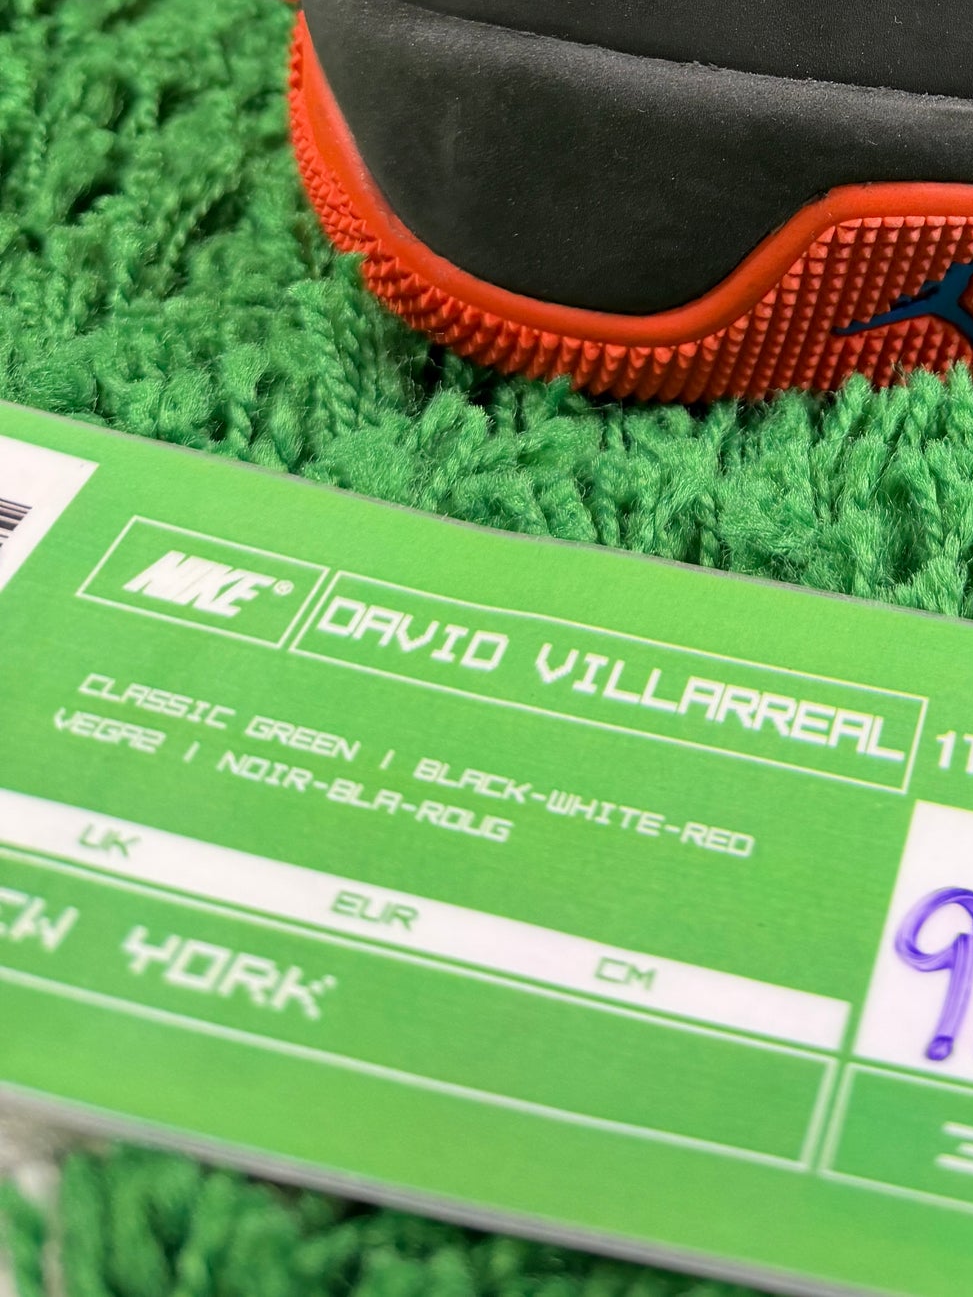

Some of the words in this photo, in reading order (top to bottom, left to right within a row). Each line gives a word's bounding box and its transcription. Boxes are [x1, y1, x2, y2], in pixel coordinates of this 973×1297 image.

[316, 595, 509, 671] DAVID
[535, 642, 905, 761] VILLARREAL
[78, 672, 236, 730] CLASSIC
[244, 715, 362, 762] GREEN
[413, 757, 755, 858] BLACK-WHITE-RED
[216, 750, 515, 843] NOIR-BLA-ROUG
[77, 823, 141, 859] UK
[330, 889, 419, 932] EUR
[121, 924, 338, 1020] YORK
[593, 955, 657, 991] CM
